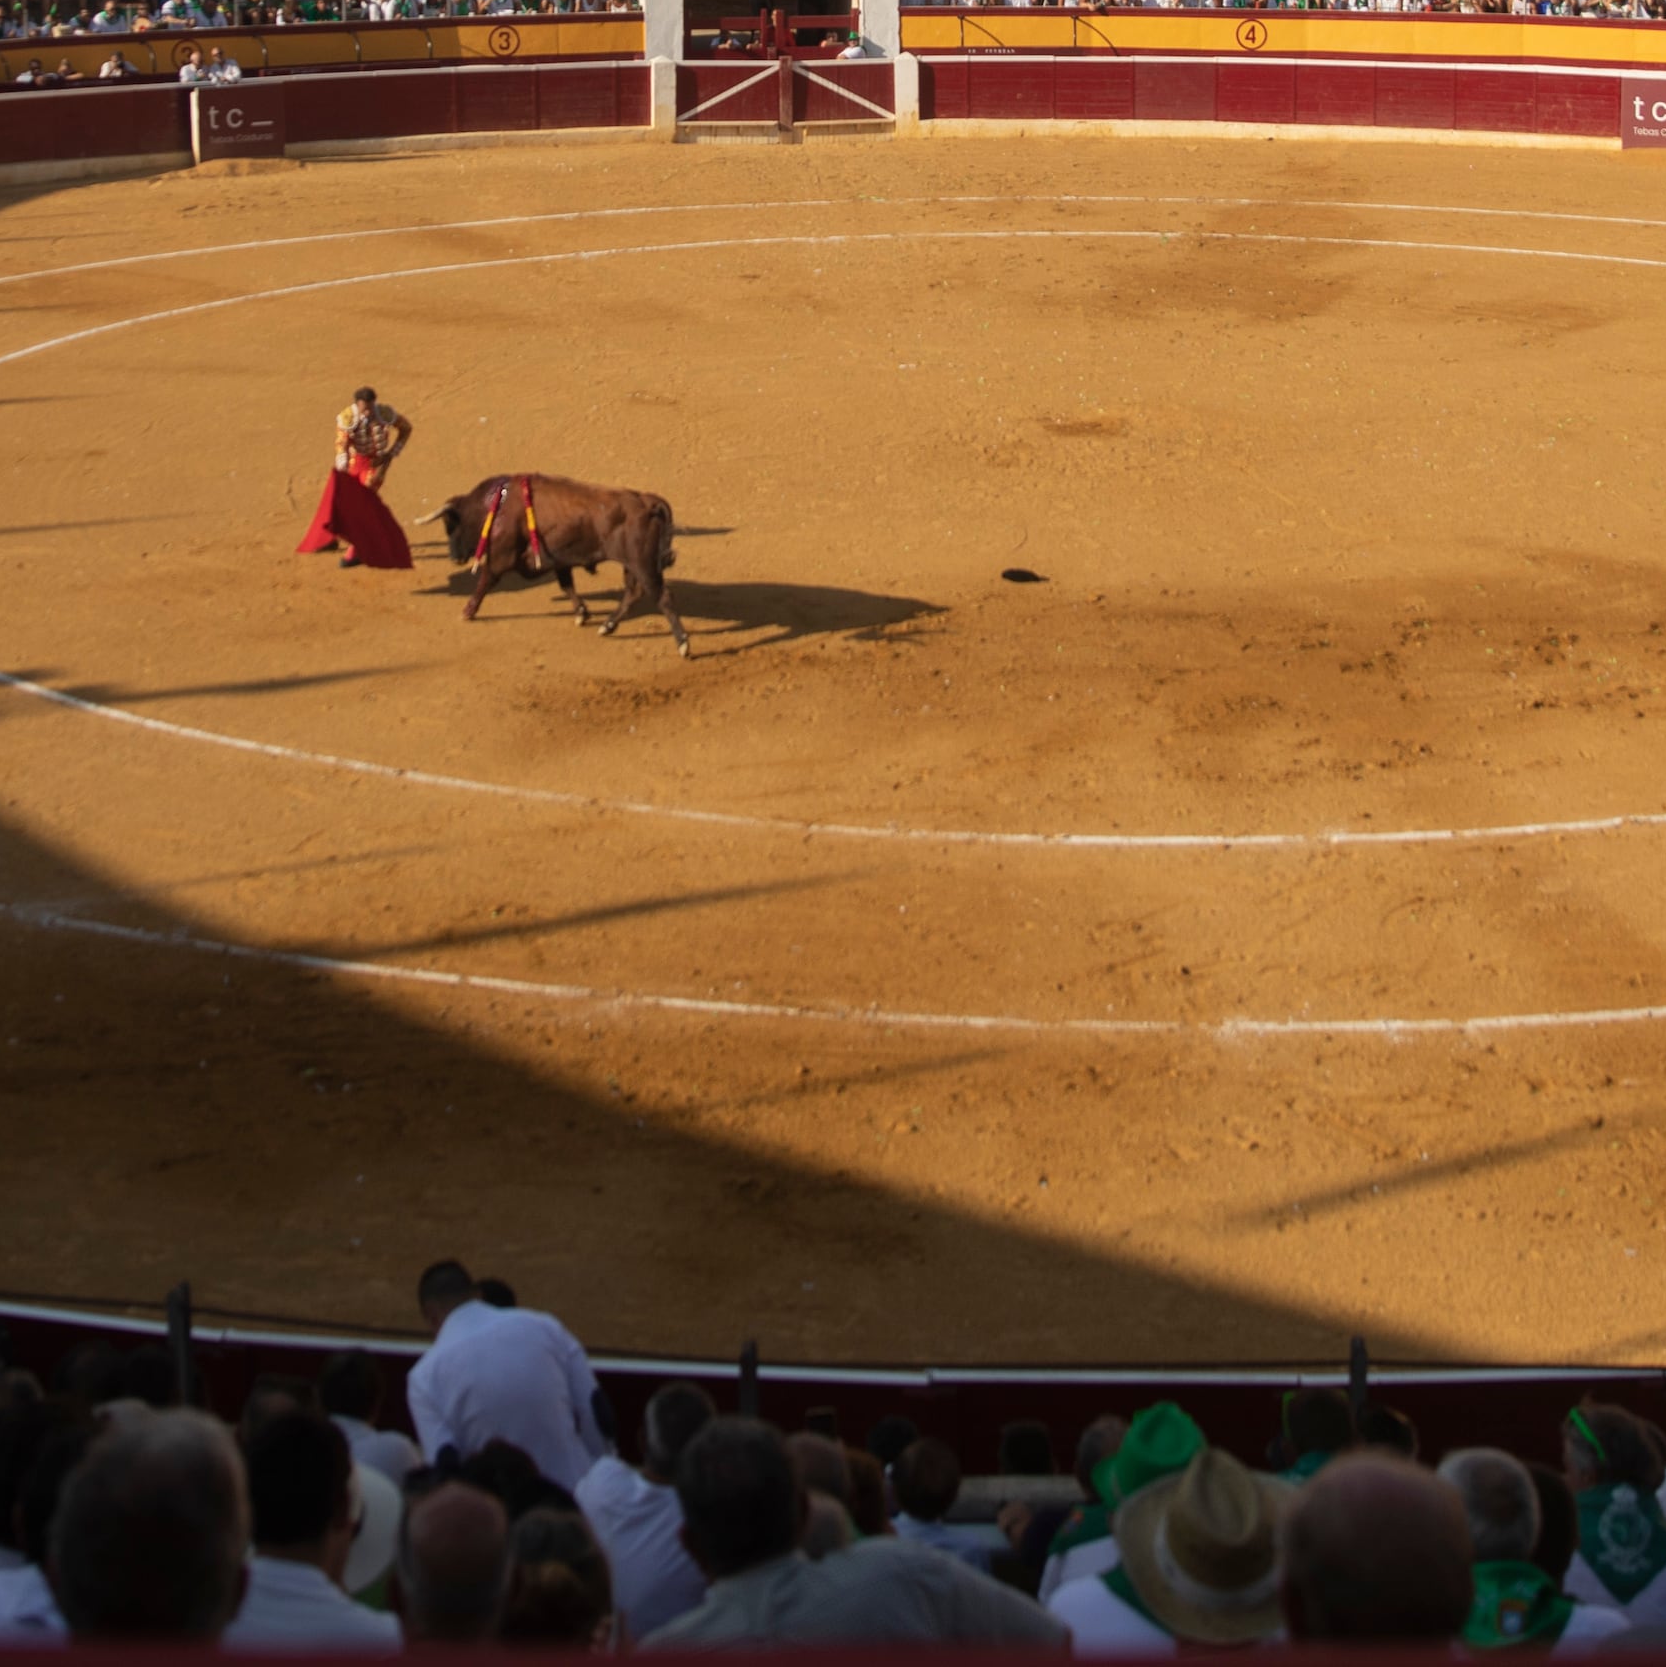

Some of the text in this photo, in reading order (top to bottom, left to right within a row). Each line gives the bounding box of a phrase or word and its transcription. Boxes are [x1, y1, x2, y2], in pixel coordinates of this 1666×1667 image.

[498, 31, 511, 50] 3
[1245, 25, 1257, 44] 4
[1633, 127, 1659, 136] Tebas
